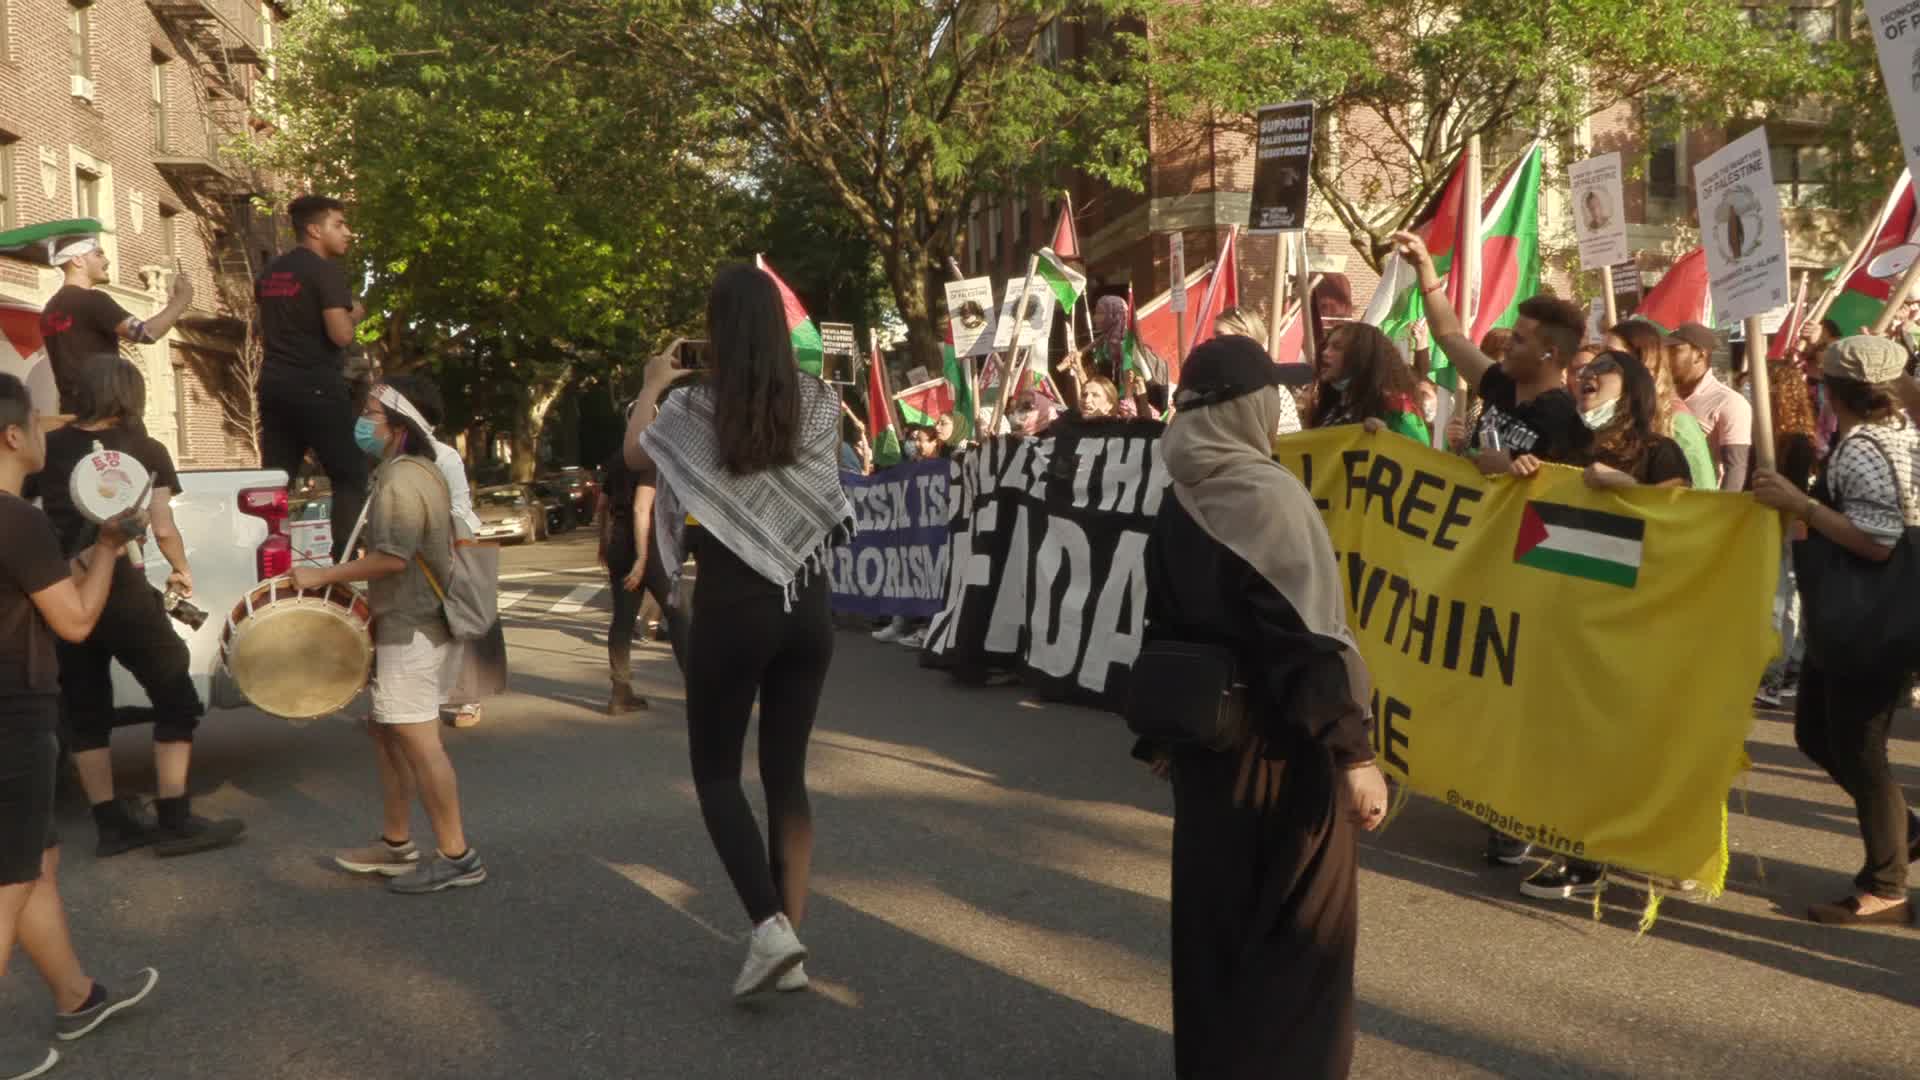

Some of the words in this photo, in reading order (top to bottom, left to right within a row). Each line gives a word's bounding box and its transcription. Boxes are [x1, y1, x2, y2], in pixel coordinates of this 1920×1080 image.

[1886, 19, 1906, 40] OF
[1260, 132, 1309, 145] PALESTINIAN
[1261, 116, 1310, 132] SUPPORT
[1714, 158, 1763, 193] PALESTINE
[916, 474, 951, 527] IS
[1342, 450, 1483, 550] FREE
[1446, 789, 1585, 856] @wolpalestine
